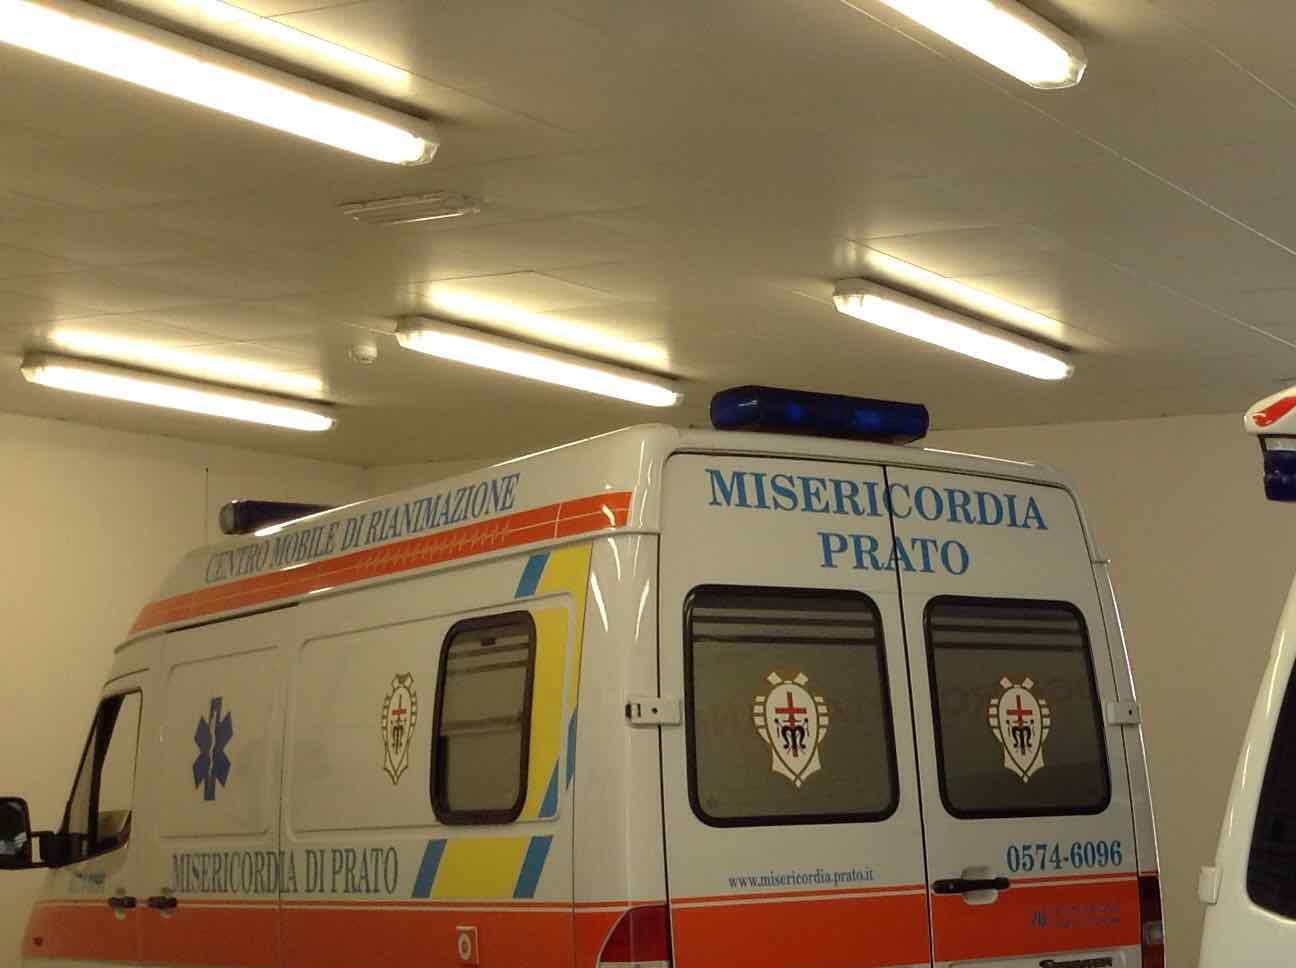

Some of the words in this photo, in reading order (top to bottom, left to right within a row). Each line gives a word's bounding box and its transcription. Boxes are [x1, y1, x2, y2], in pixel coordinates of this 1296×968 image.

[704, 468, 1049, 531] MISERICORDIA
[205, 536, 273, 584] CENTRO
[272, 523, 338, 571] MOBILE
[340, 517, 366, 555] DI
[363, 472, 521, 546] RIANIMAZIONE
[816, 532, 971, 576] PRATO
[172, 850, 299, 894] MISERICORDIA
[304, 848, 325, 893] DI
[331, 847, 399, 894] PRATO
[728, 866, 874, 889] www.misericordia.prato.it
[1007, 839, 1122, 873] 0574-6096
